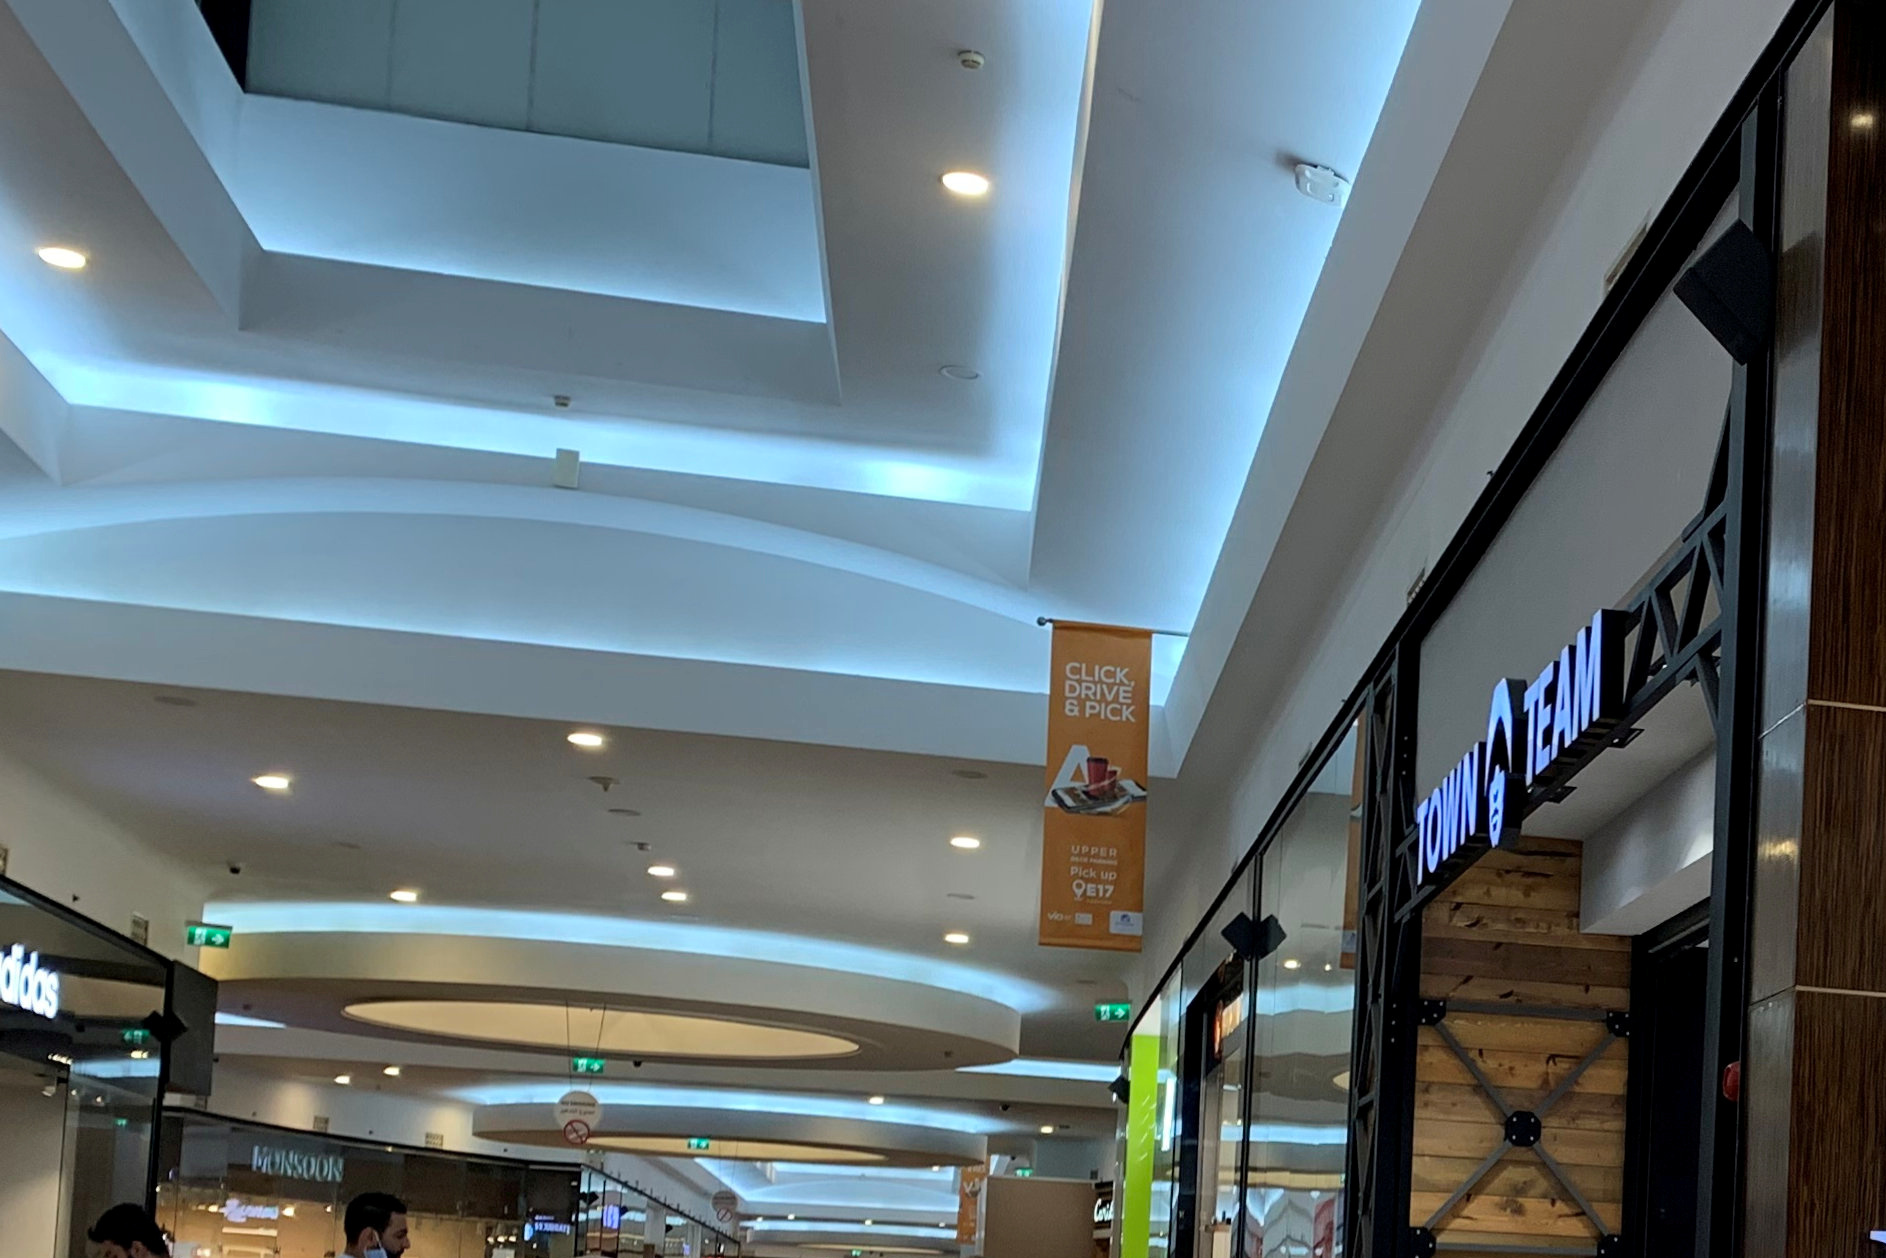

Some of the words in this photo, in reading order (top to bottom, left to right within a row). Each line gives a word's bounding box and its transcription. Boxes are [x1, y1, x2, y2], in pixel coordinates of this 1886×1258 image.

[1064, 680, 1132, 703] DRIVE
[1064, 699, 1079, 717] &
[1085, 701, 1136, 722] PICK
[1416, 741, 1479, 886] TOWN
[1523, 608, 1602, 787] TEAM
[1071, 845, 1117, 858] UPPER
[1086, 883, 1115, 898] E17
[251, 1145, 344, 1183] MONSOON
